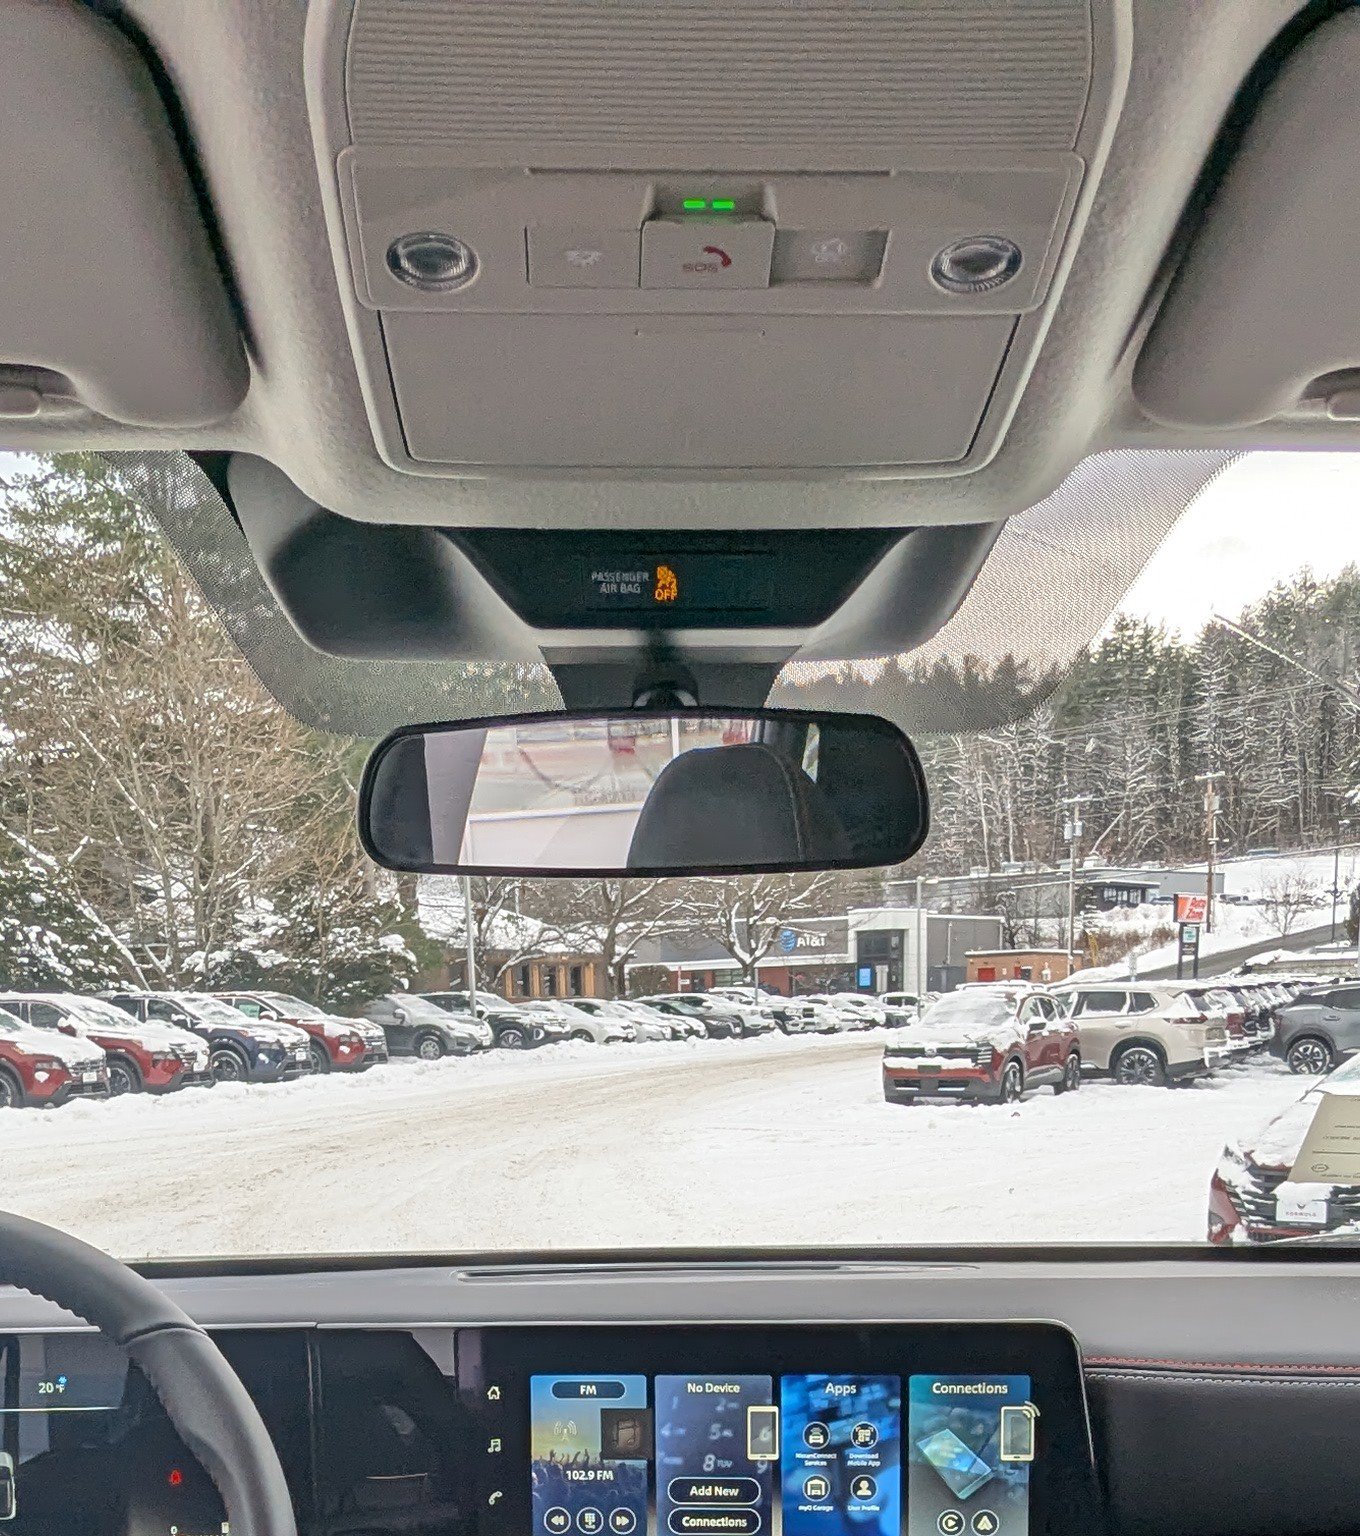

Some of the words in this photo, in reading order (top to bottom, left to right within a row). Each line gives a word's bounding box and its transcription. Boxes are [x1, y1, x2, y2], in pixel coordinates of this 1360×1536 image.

[683, 263, 718, 272] SOS
[591, 571, 650, 583] PASSENGER
[600, 583, 618, 594] AIR
[620, 582, 641, 594] BAG
[654, 589, 678, 601] OFF
[797, 933, 827, 947] AT&T
[38, 1382, 54, 1394] 20
[580, 1385, 597, 1396] FM
[687, 1383, 703, 1394] No
[705, 1382, 740, 1394] Device
[825, 1383, 857, 1396] Apps
[932, 1382, 1008, 1395] Connections
[703, 1454, 716, 1472] 8
[566, 1470, 595, 1481] 102.9
[597, 1470, 614, 1481] FM
[690, 1486, 711, 1497] Add
[714, 1486, 739, 1497] New
[682, 1516, 748, 1528] Connections
[171, 1525, 178, 1534] 0
